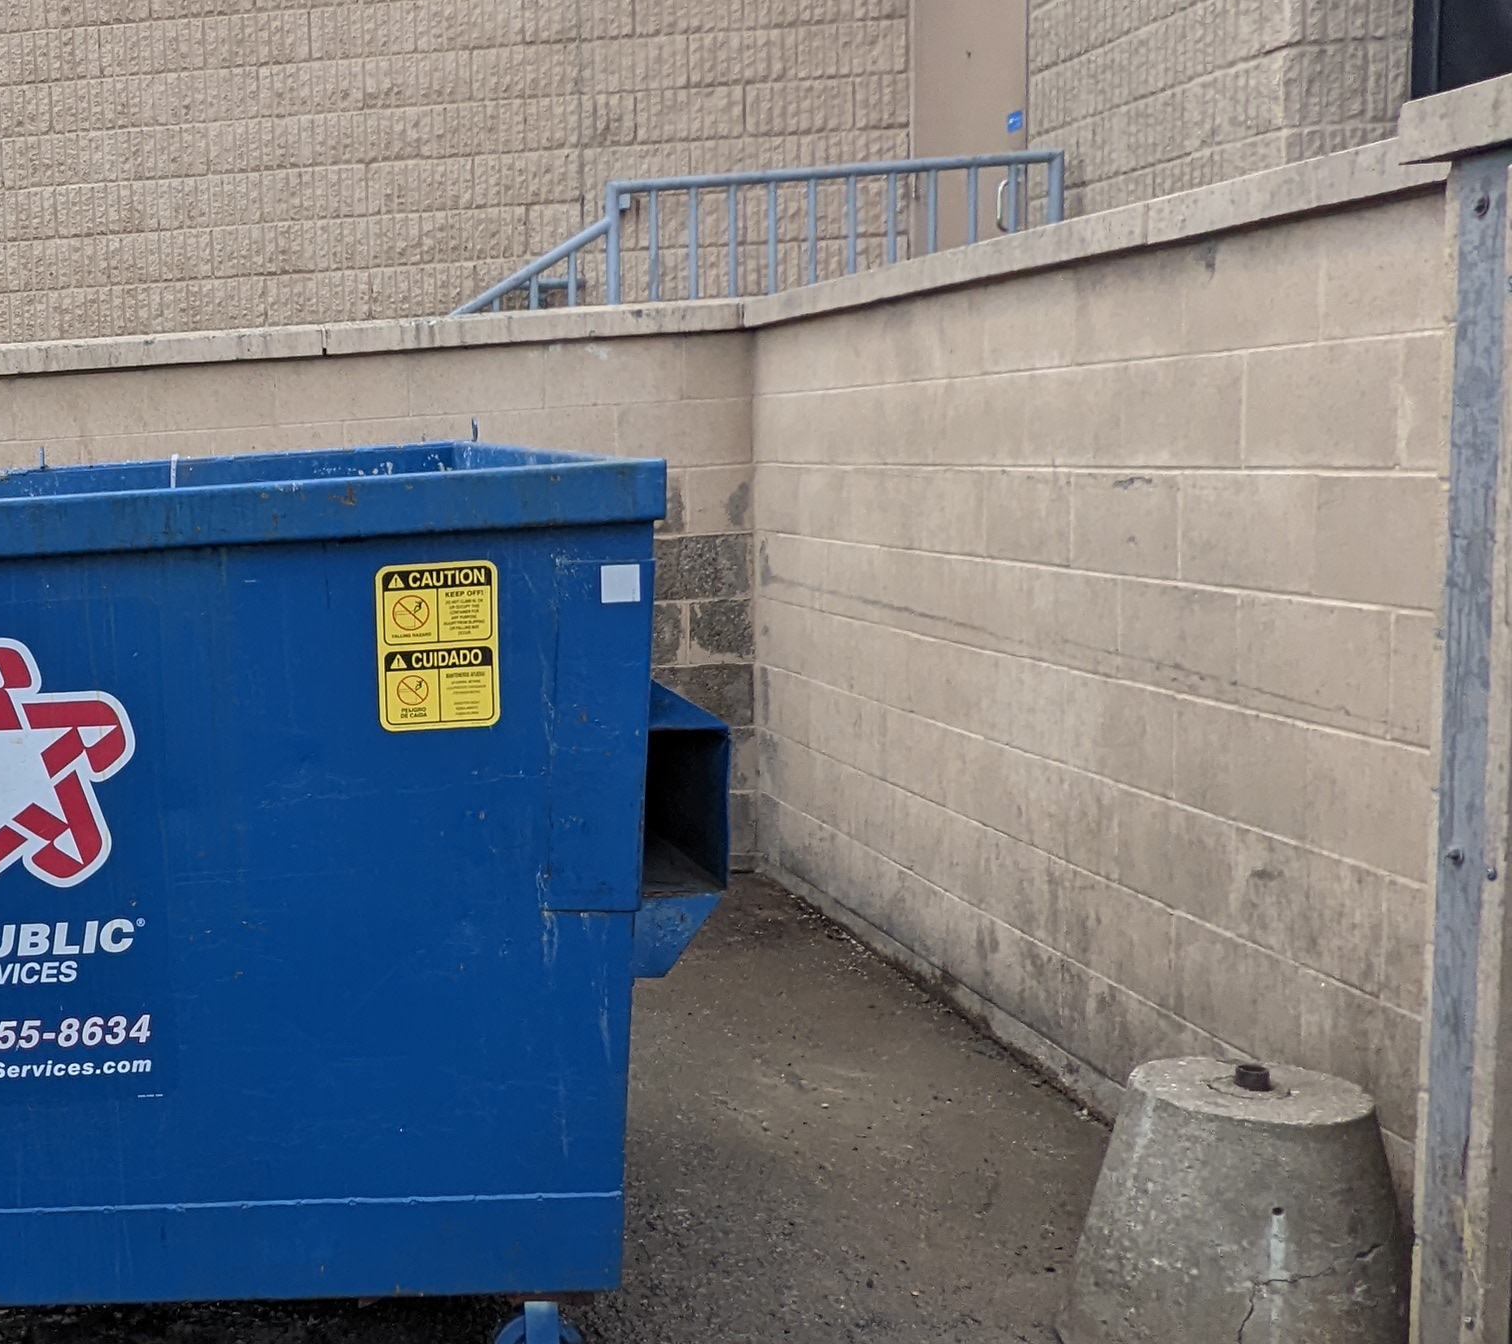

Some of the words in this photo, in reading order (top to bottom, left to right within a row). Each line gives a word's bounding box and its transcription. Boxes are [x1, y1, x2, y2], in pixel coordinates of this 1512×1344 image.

[408, 568, 485, 587] CAUTION
[445, 590, 465, 598] KEEP
[411, 649, 482, 668] CUIDADO
